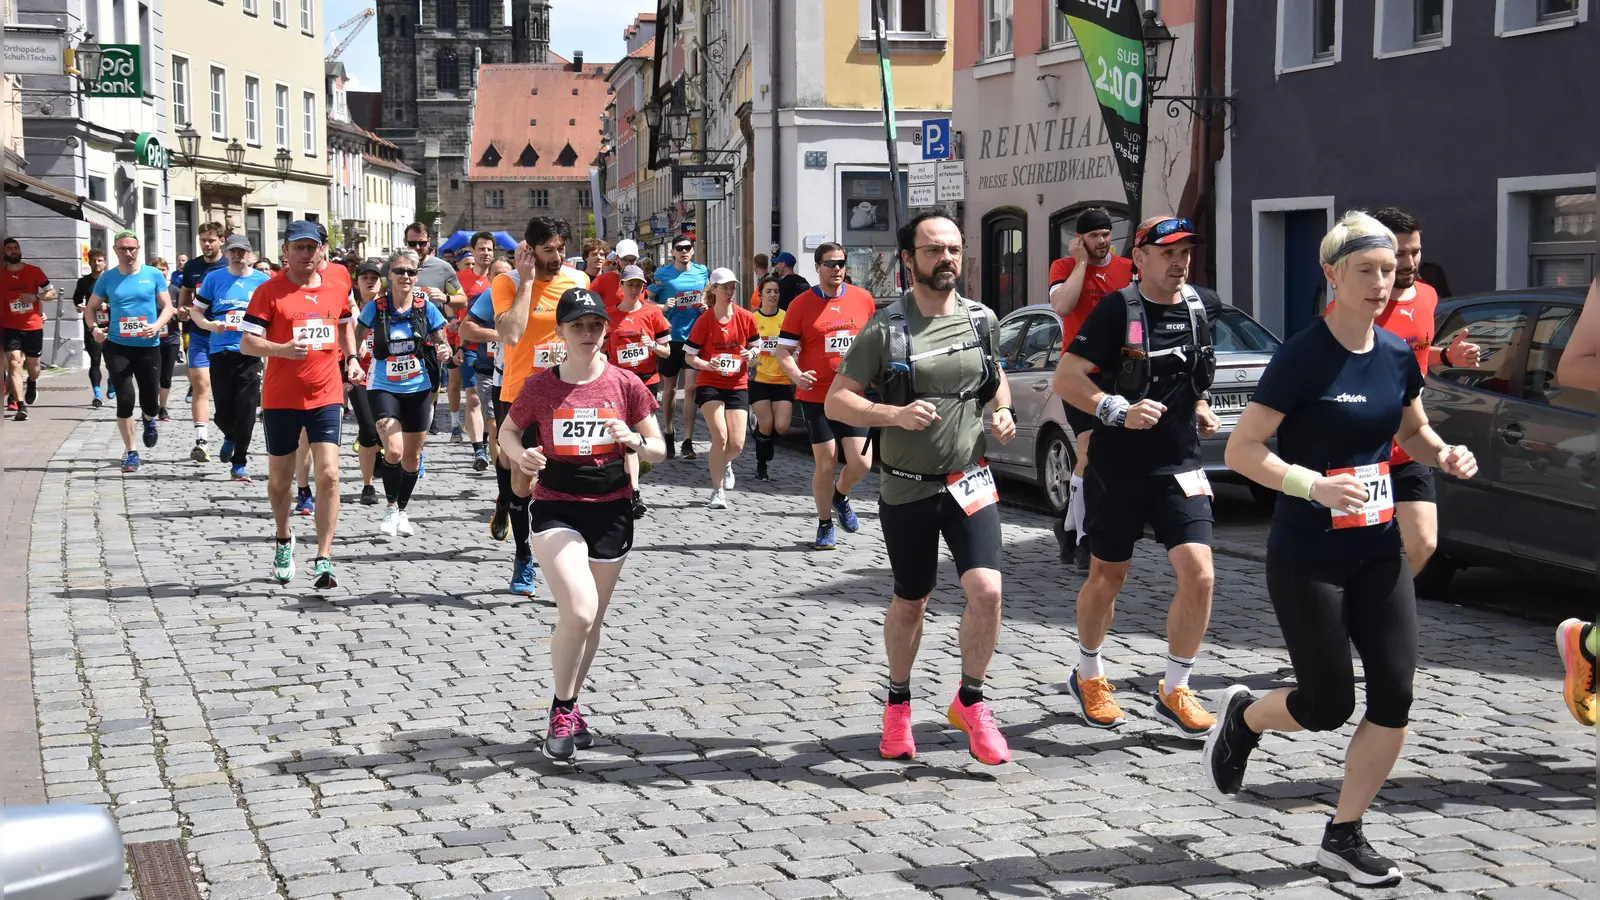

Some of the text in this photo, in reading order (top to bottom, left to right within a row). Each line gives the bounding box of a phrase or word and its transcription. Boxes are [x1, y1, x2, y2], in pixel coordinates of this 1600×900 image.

[4, 45, 46, 54] Orthopädie
[4, 53, 57, 62] Schuh Technik
[1117, 48, 1139, 66] SUB
[99, 57, 134, 77] psd
[1095, 56, 1142, 107] 2:00
[926, 124, 942, 155] P
[979, 113, 1109, 160] REINTHAL
[978, 155, 1116, 190] PRESSE SCHREIBWAREN
[573, 290, 596, 306] LA
[680, 295, 697, 304] 2527
[123, 322, 143, 330] 2654
[1172, 323, 1185, 331] cep
[300, 327, 330, 339] 2720
[764, 341, 778, 349] 252
[830, 337, 853, 348] 2701
[622, 348, 644, 359] 2664
[391, 360, 416, 372] 2613
[1214, 395, 1231, 409] AN
[562, 421, 607, 438] 2577
[892, 469, 916, 479] salomon
